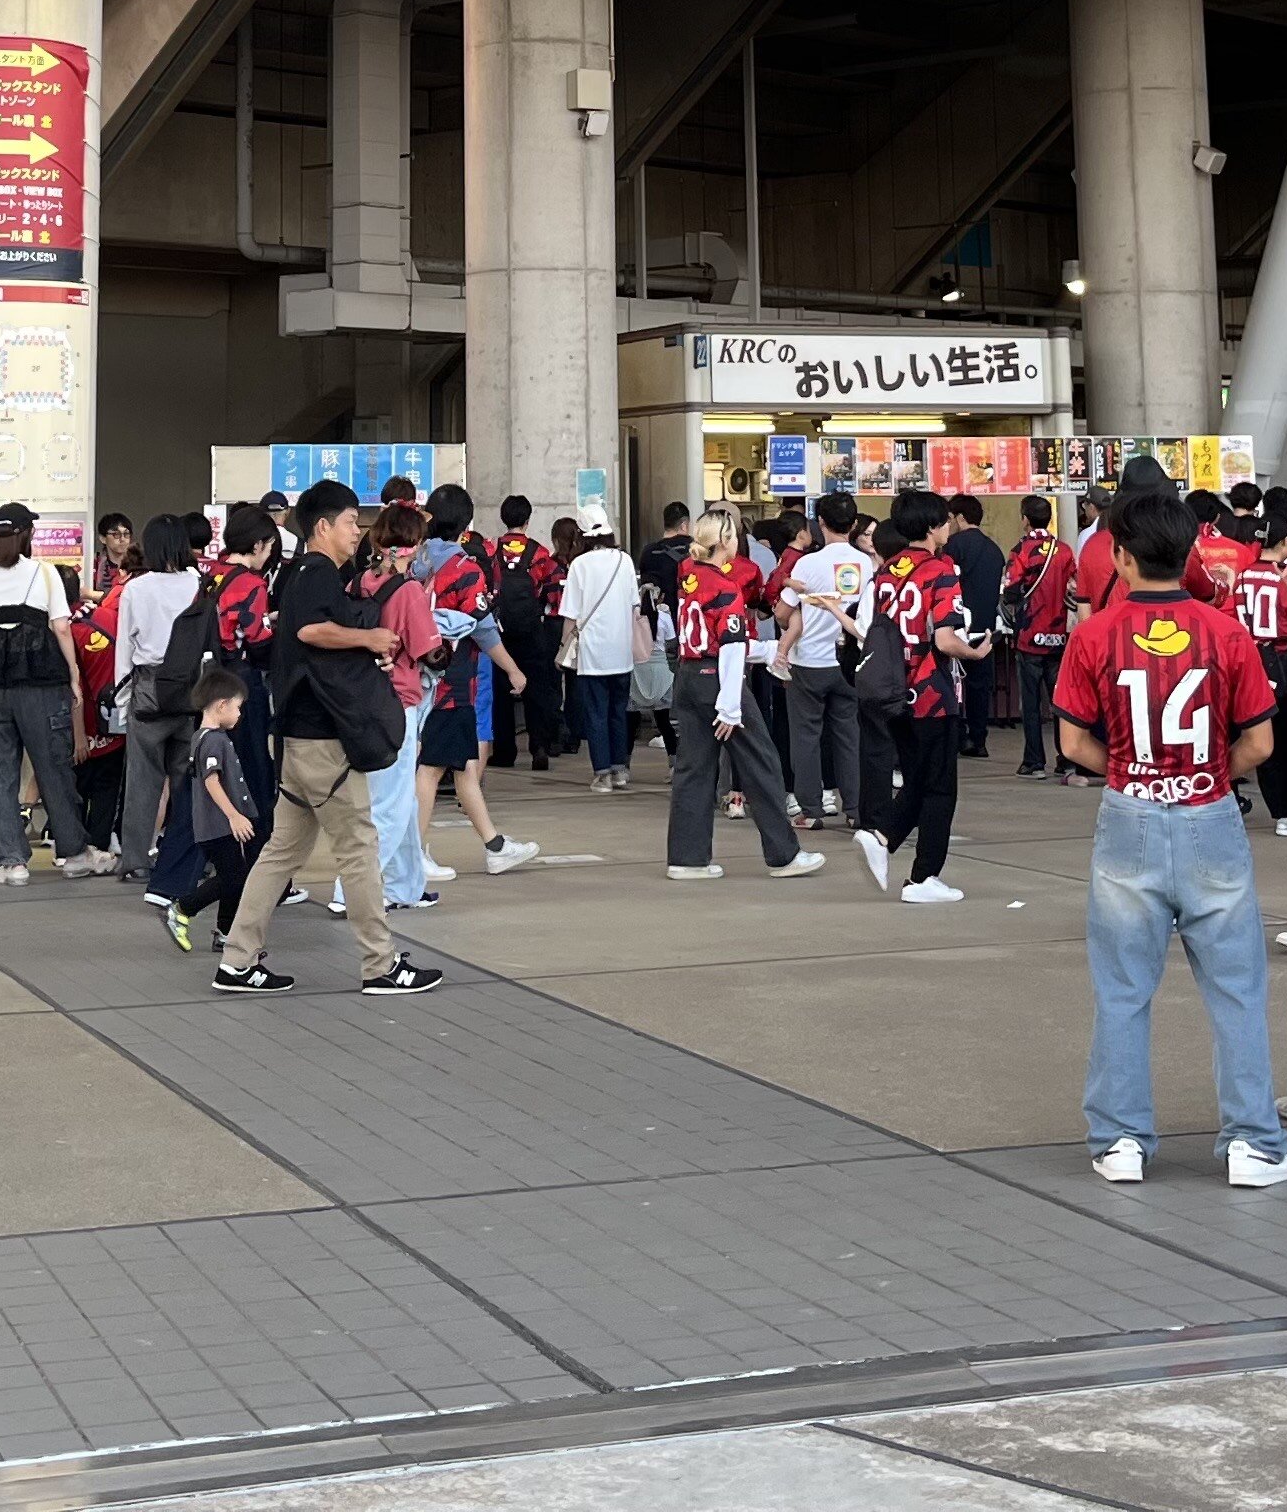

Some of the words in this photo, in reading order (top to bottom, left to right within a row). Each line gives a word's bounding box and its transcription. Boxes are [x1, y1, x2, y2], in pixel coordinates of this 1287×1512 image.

[404, 448, 423, 485] 牛串
[1117, 668, 1210, 765] 14
[1148, 772, 1214, 803] RISO
